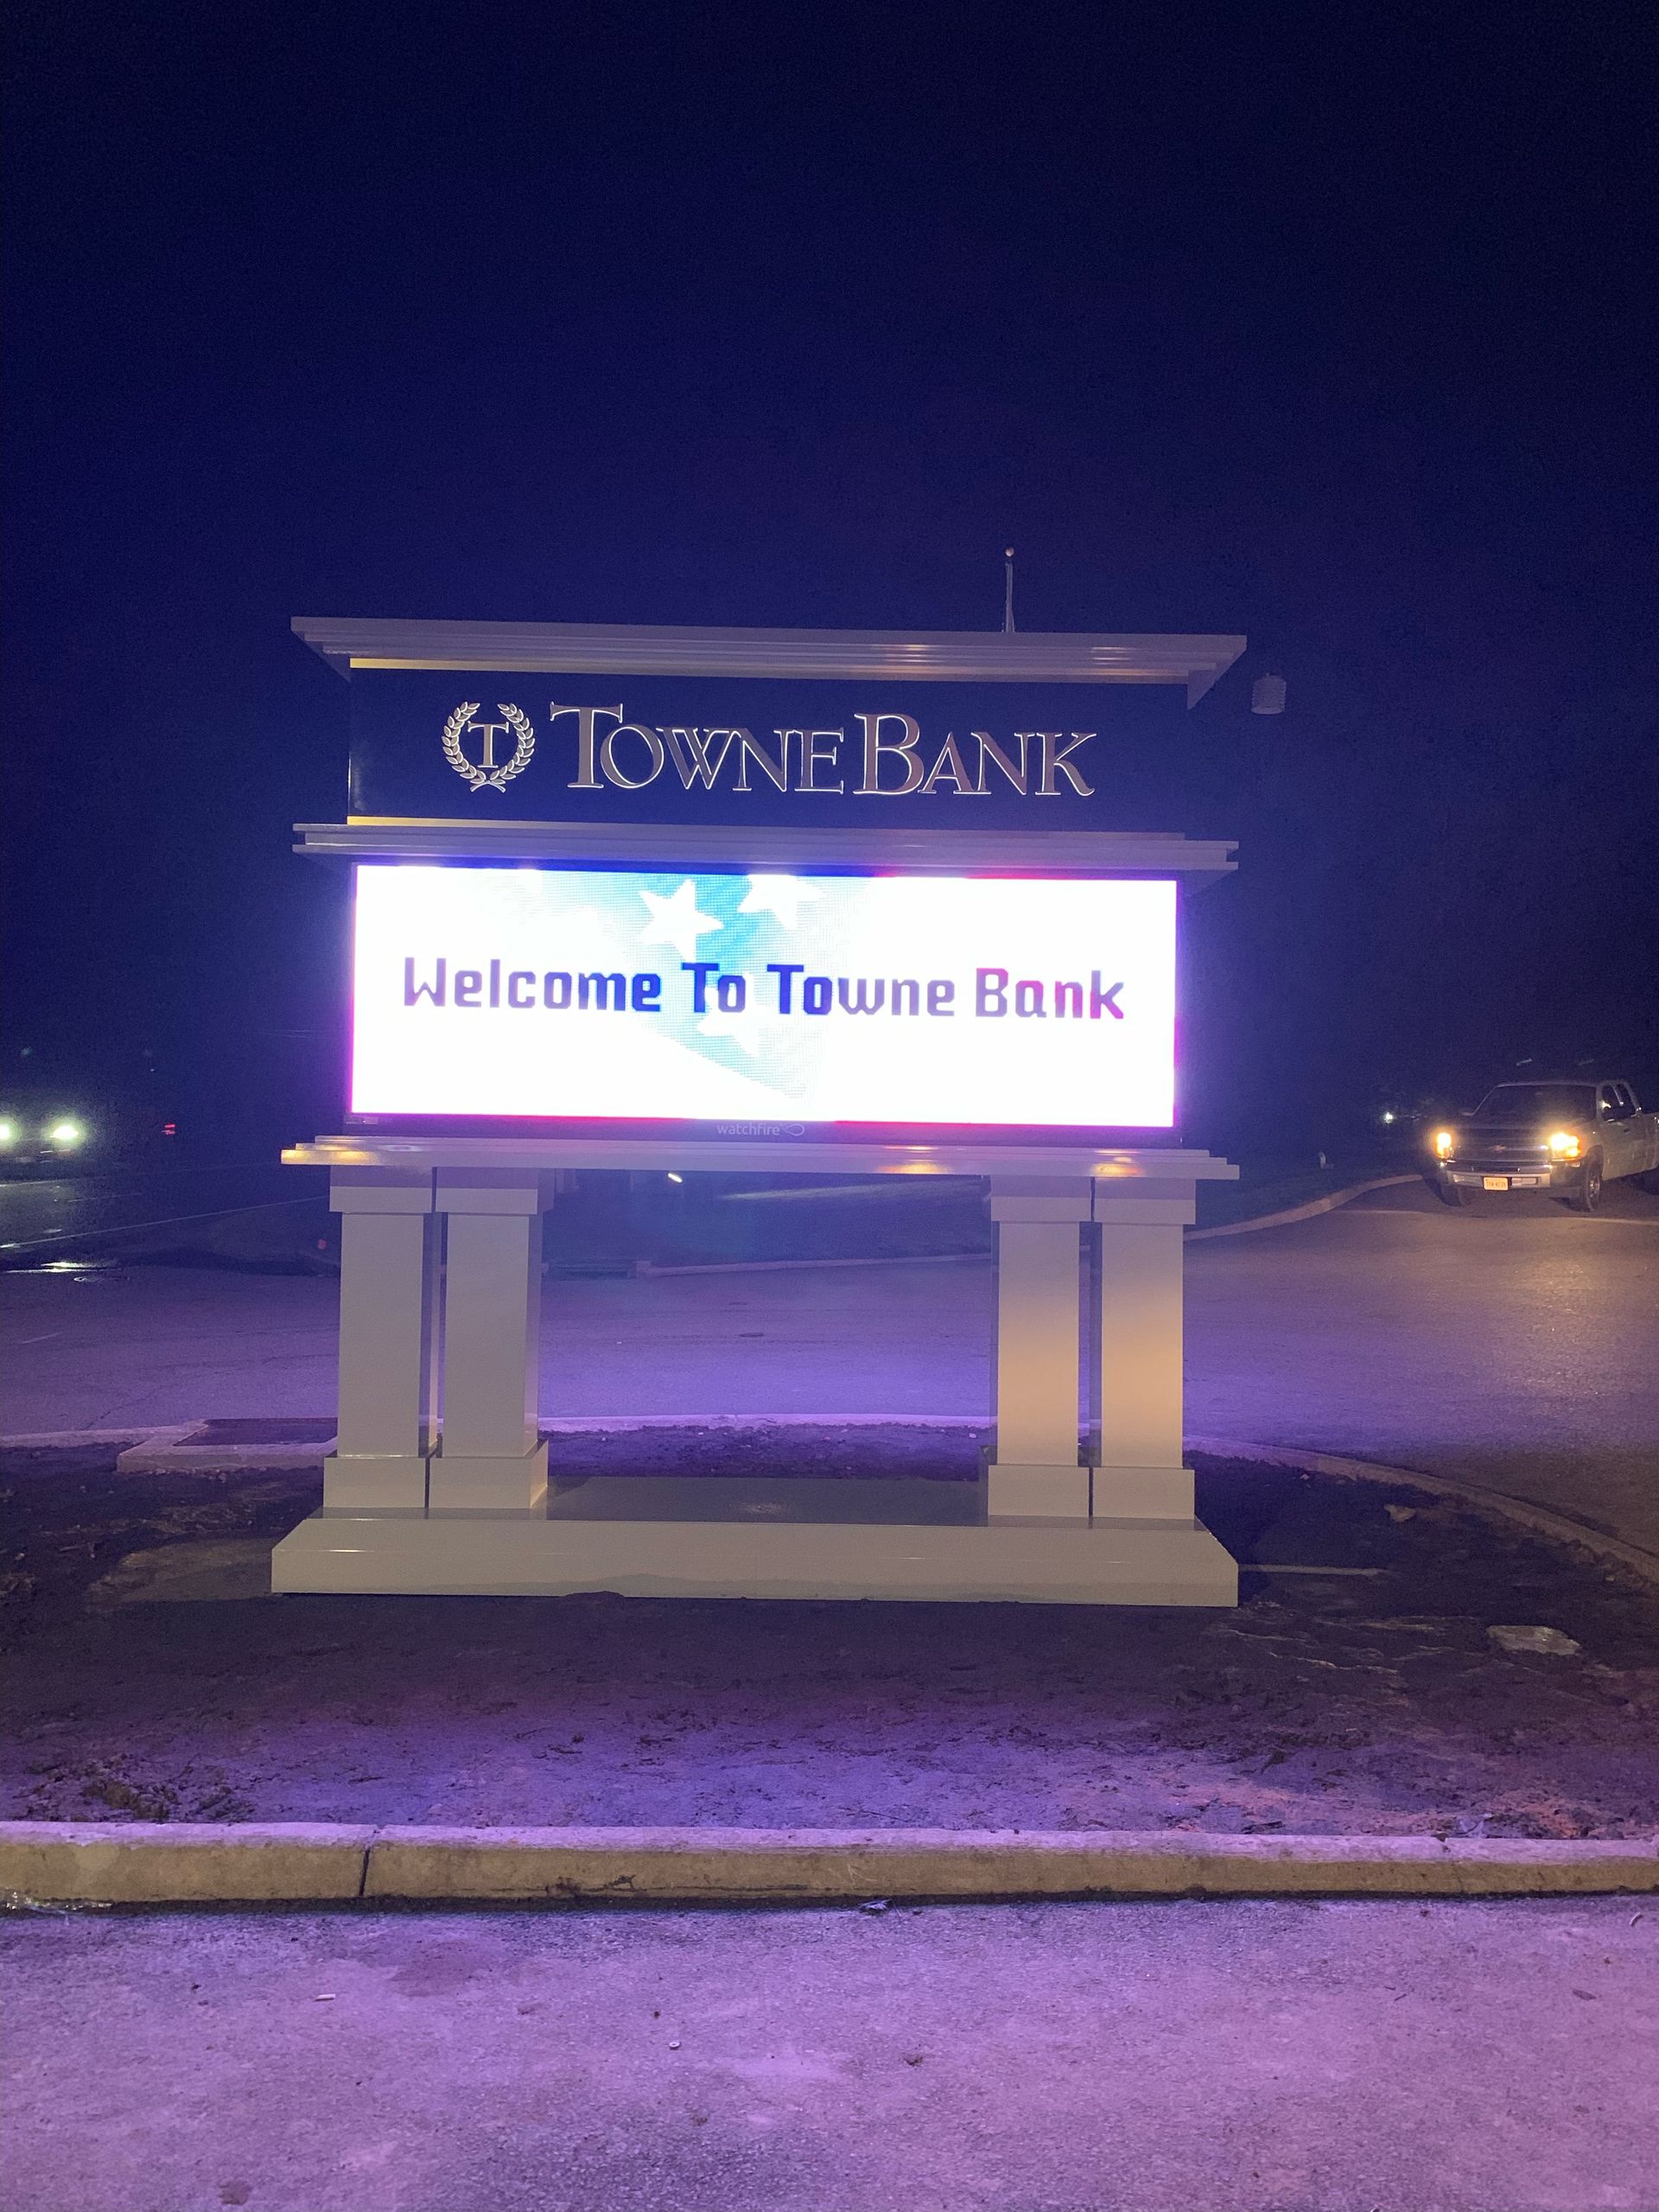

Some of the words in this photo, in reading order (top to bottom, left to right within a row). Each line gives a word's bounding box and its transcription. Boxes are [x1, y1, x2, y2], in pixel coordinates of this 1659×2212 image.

[467, 720, 510, 768] T
[404, 957, 662, 1013] Welcome
[681, 962, 746, 1014] To
[766, 963, 956, 1017] Towne
[976, 967, 1124, 1020] Bank
[716, 1122, 780, 1136] watchfire
